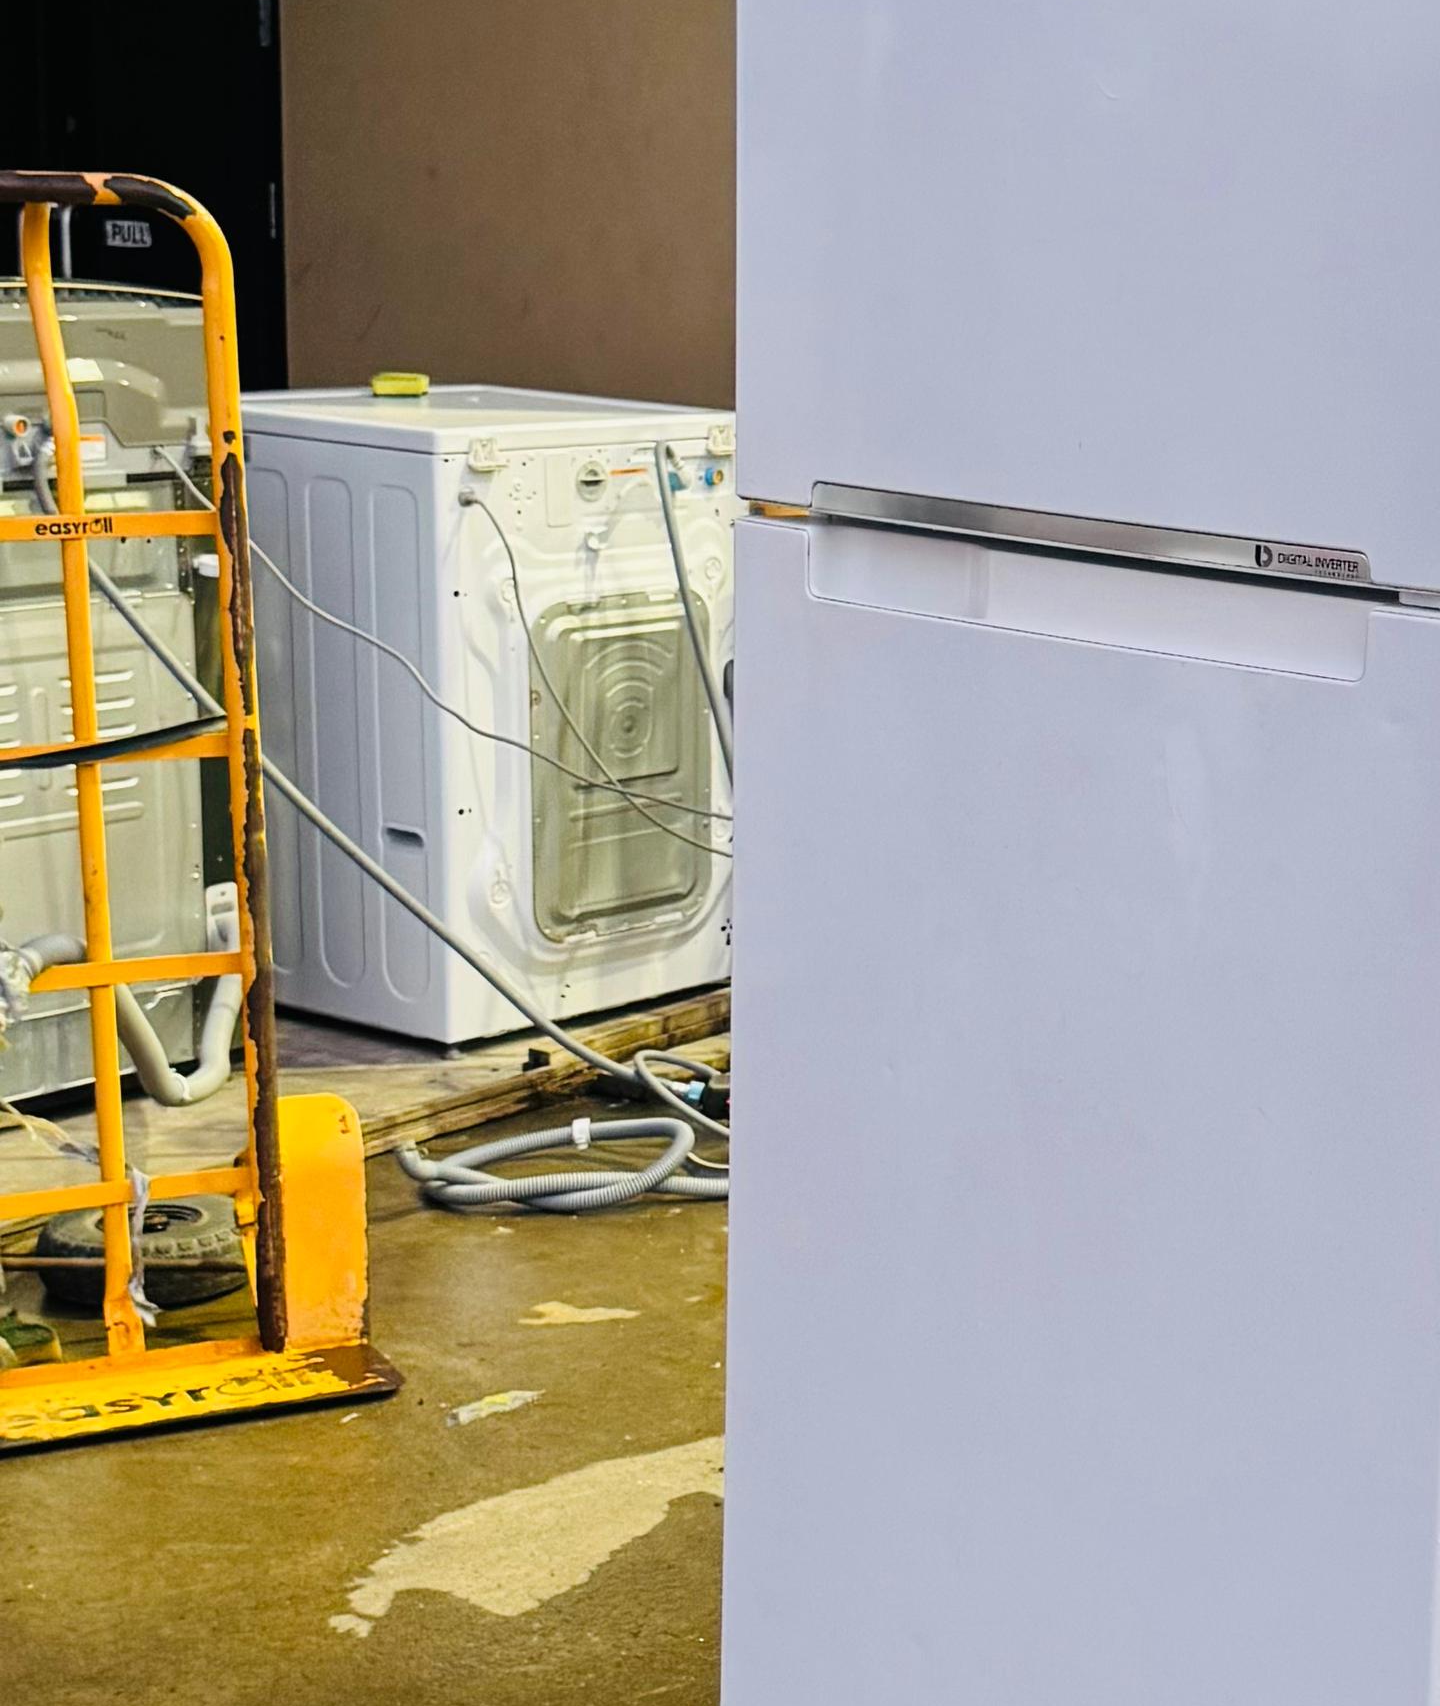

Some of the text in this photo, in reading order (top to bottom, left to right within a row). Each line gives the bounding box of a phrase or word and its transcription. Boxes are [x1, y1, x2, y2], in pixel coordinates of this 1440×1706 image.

[110, 223, 148, 245] PULL
[34, 516, 113, 536] easyroll
[1277, 553, 1313, 567] DIGITAL
[1315, 557, 1359, 573] INVERTER
